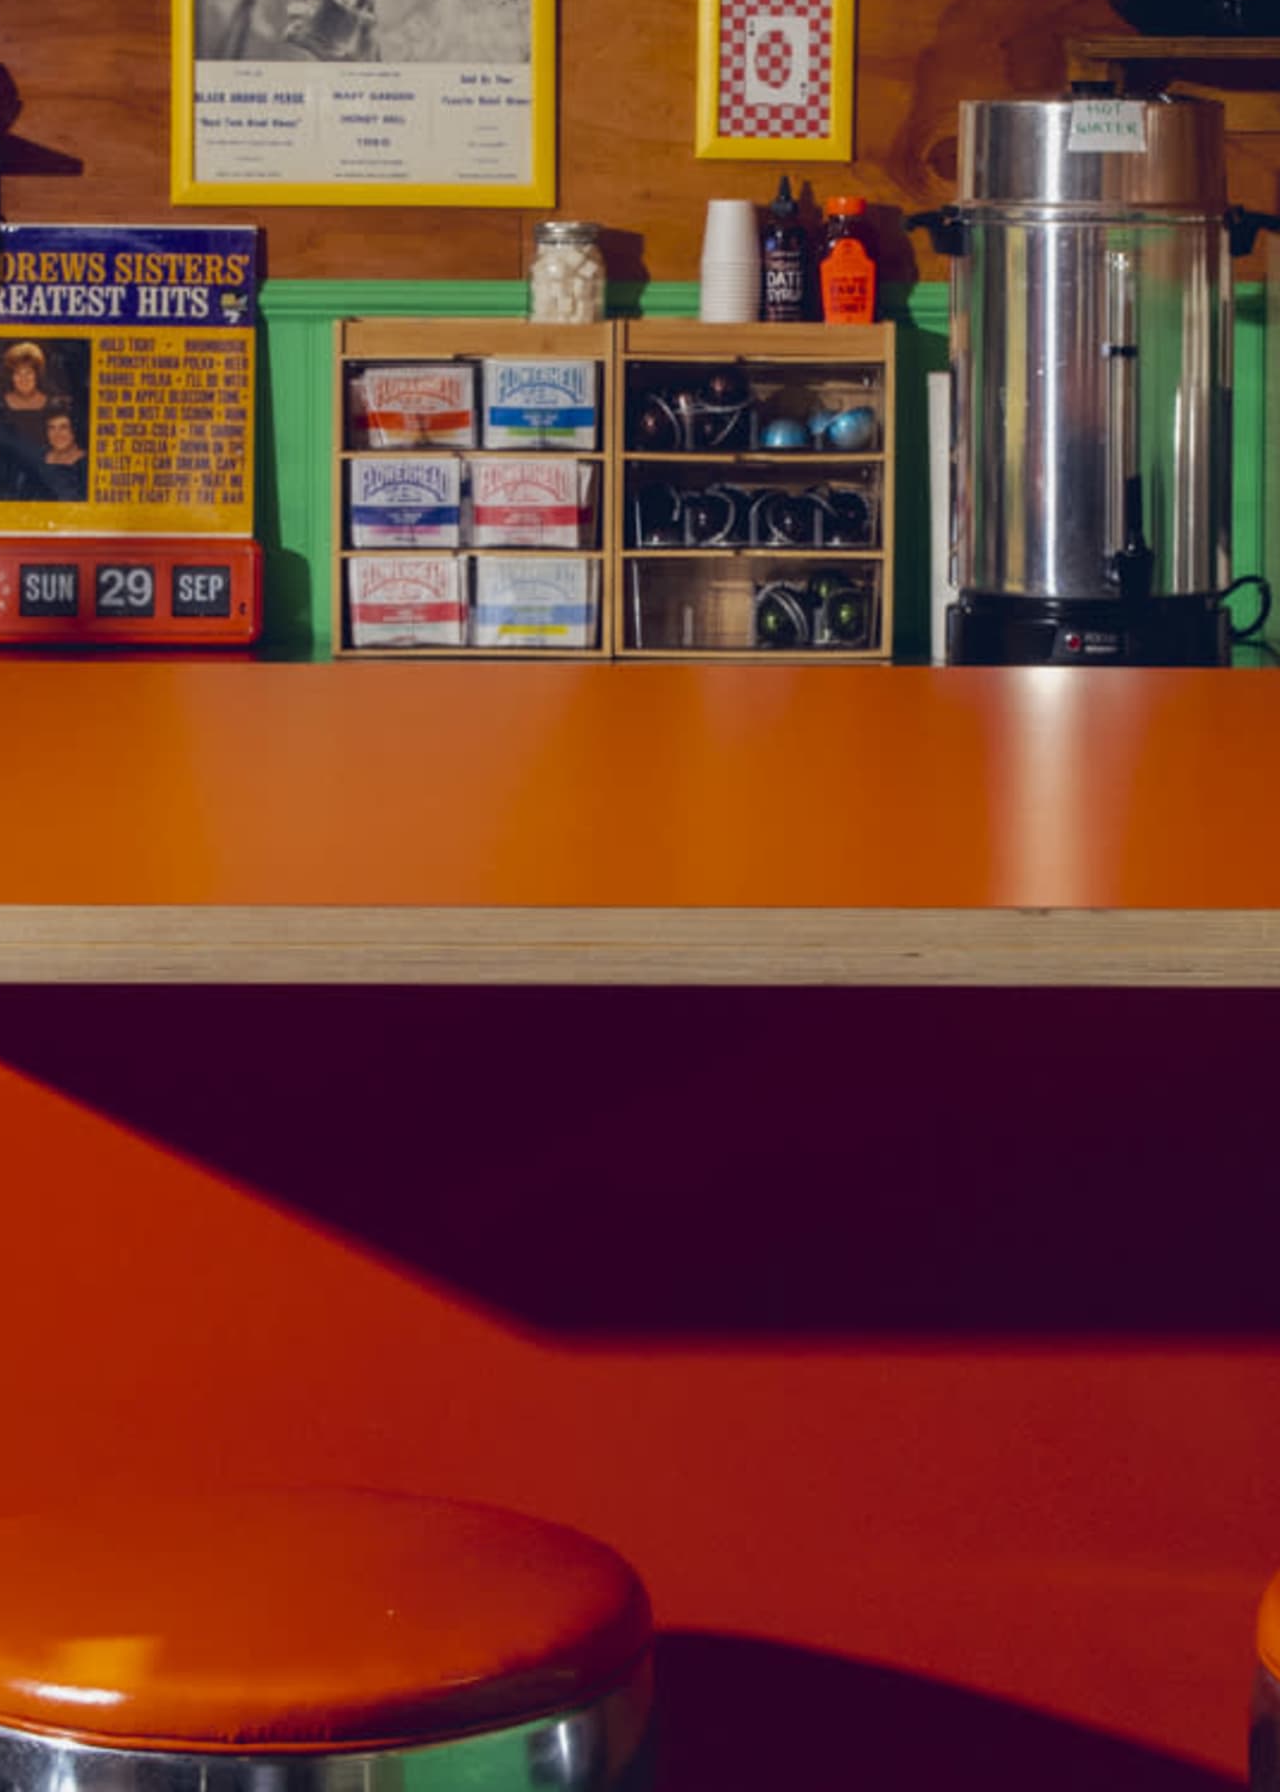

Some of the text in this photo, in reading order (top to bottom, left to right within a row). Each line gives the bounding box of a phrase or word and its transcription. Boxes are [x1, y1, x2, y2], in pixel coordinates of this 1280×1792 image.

[1086, 102, 1123, 116] HOT
[1075, 121, 1137, 136] WATER
[114, 253, 251, 286] SISTERS'
[136, 287, 210, 318] HITS
[25, 572, 74, 602] SUN
[98, 569, 154, 607] 29
[177, 573, 224, 602] SEP
